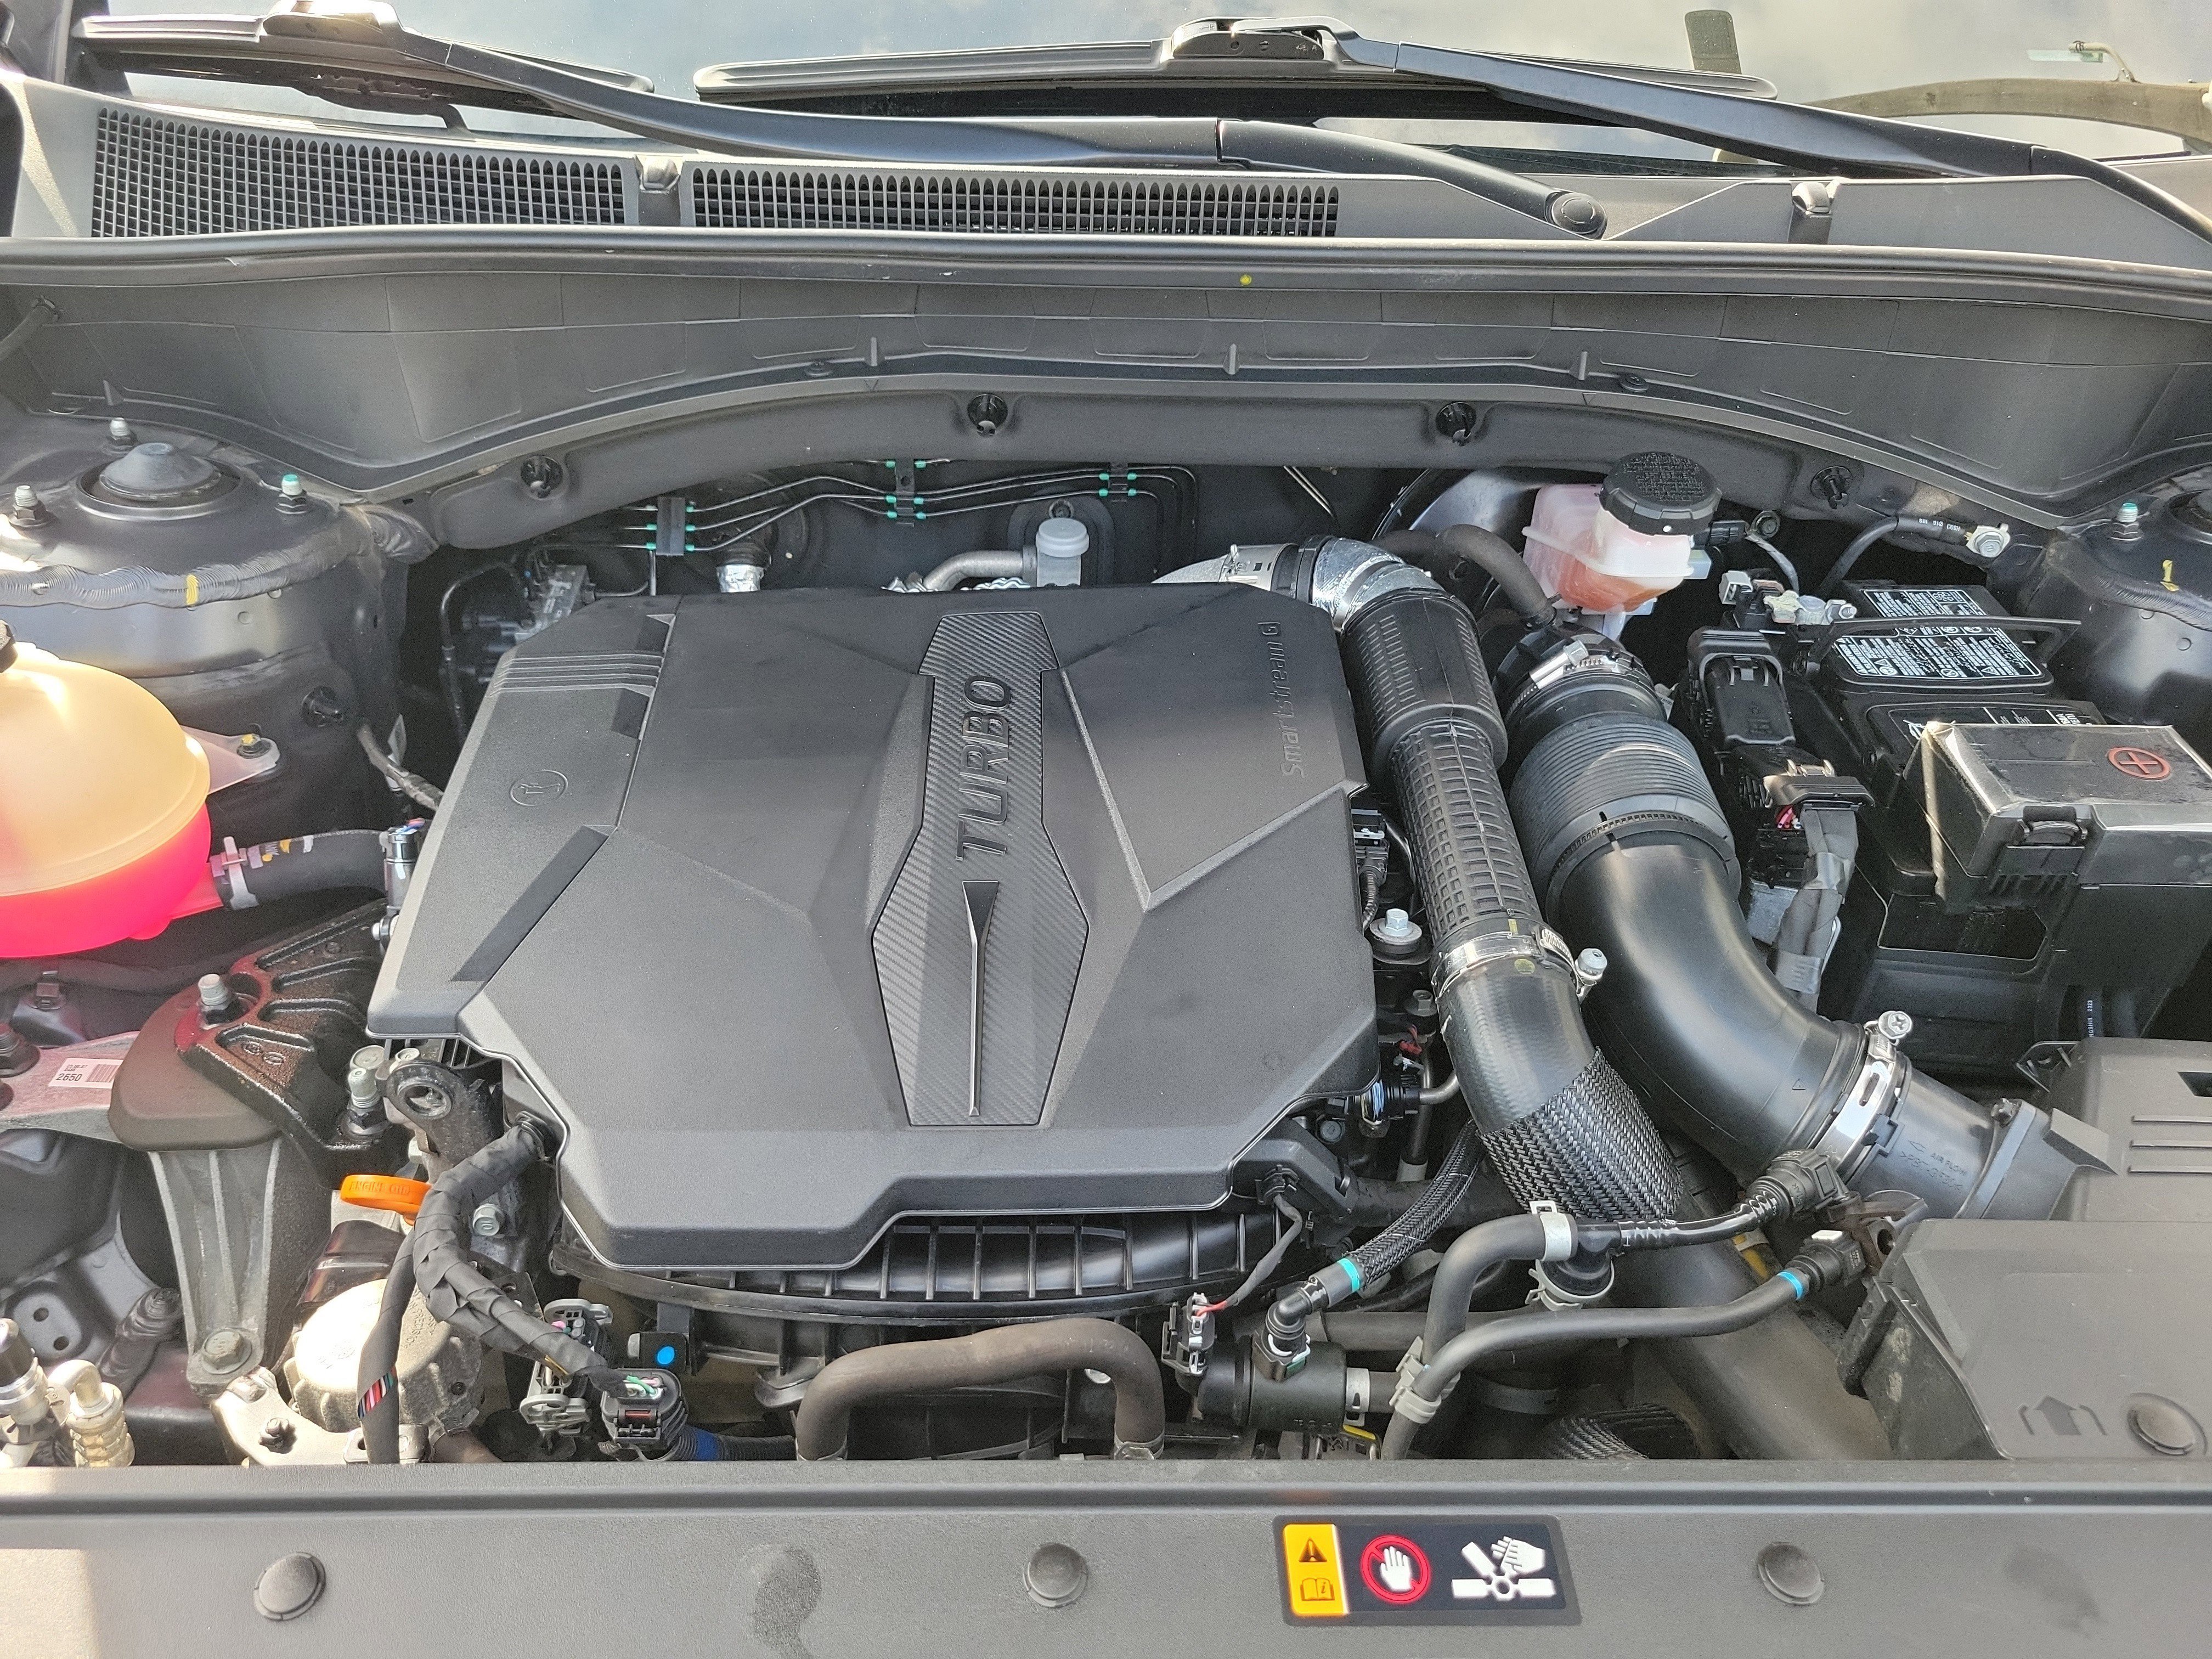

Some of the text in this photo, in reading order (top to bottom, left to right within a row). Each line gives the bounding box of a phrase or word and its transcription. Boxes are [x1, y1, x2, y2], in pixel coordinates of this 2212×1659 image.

[1267, 641, 1305, 778] Smartstream
[956, 675, 1011, 861] TURBO
[55, 1073, 82, 1081] 2650
[1930, 1153, 1944, 1164] AIR
